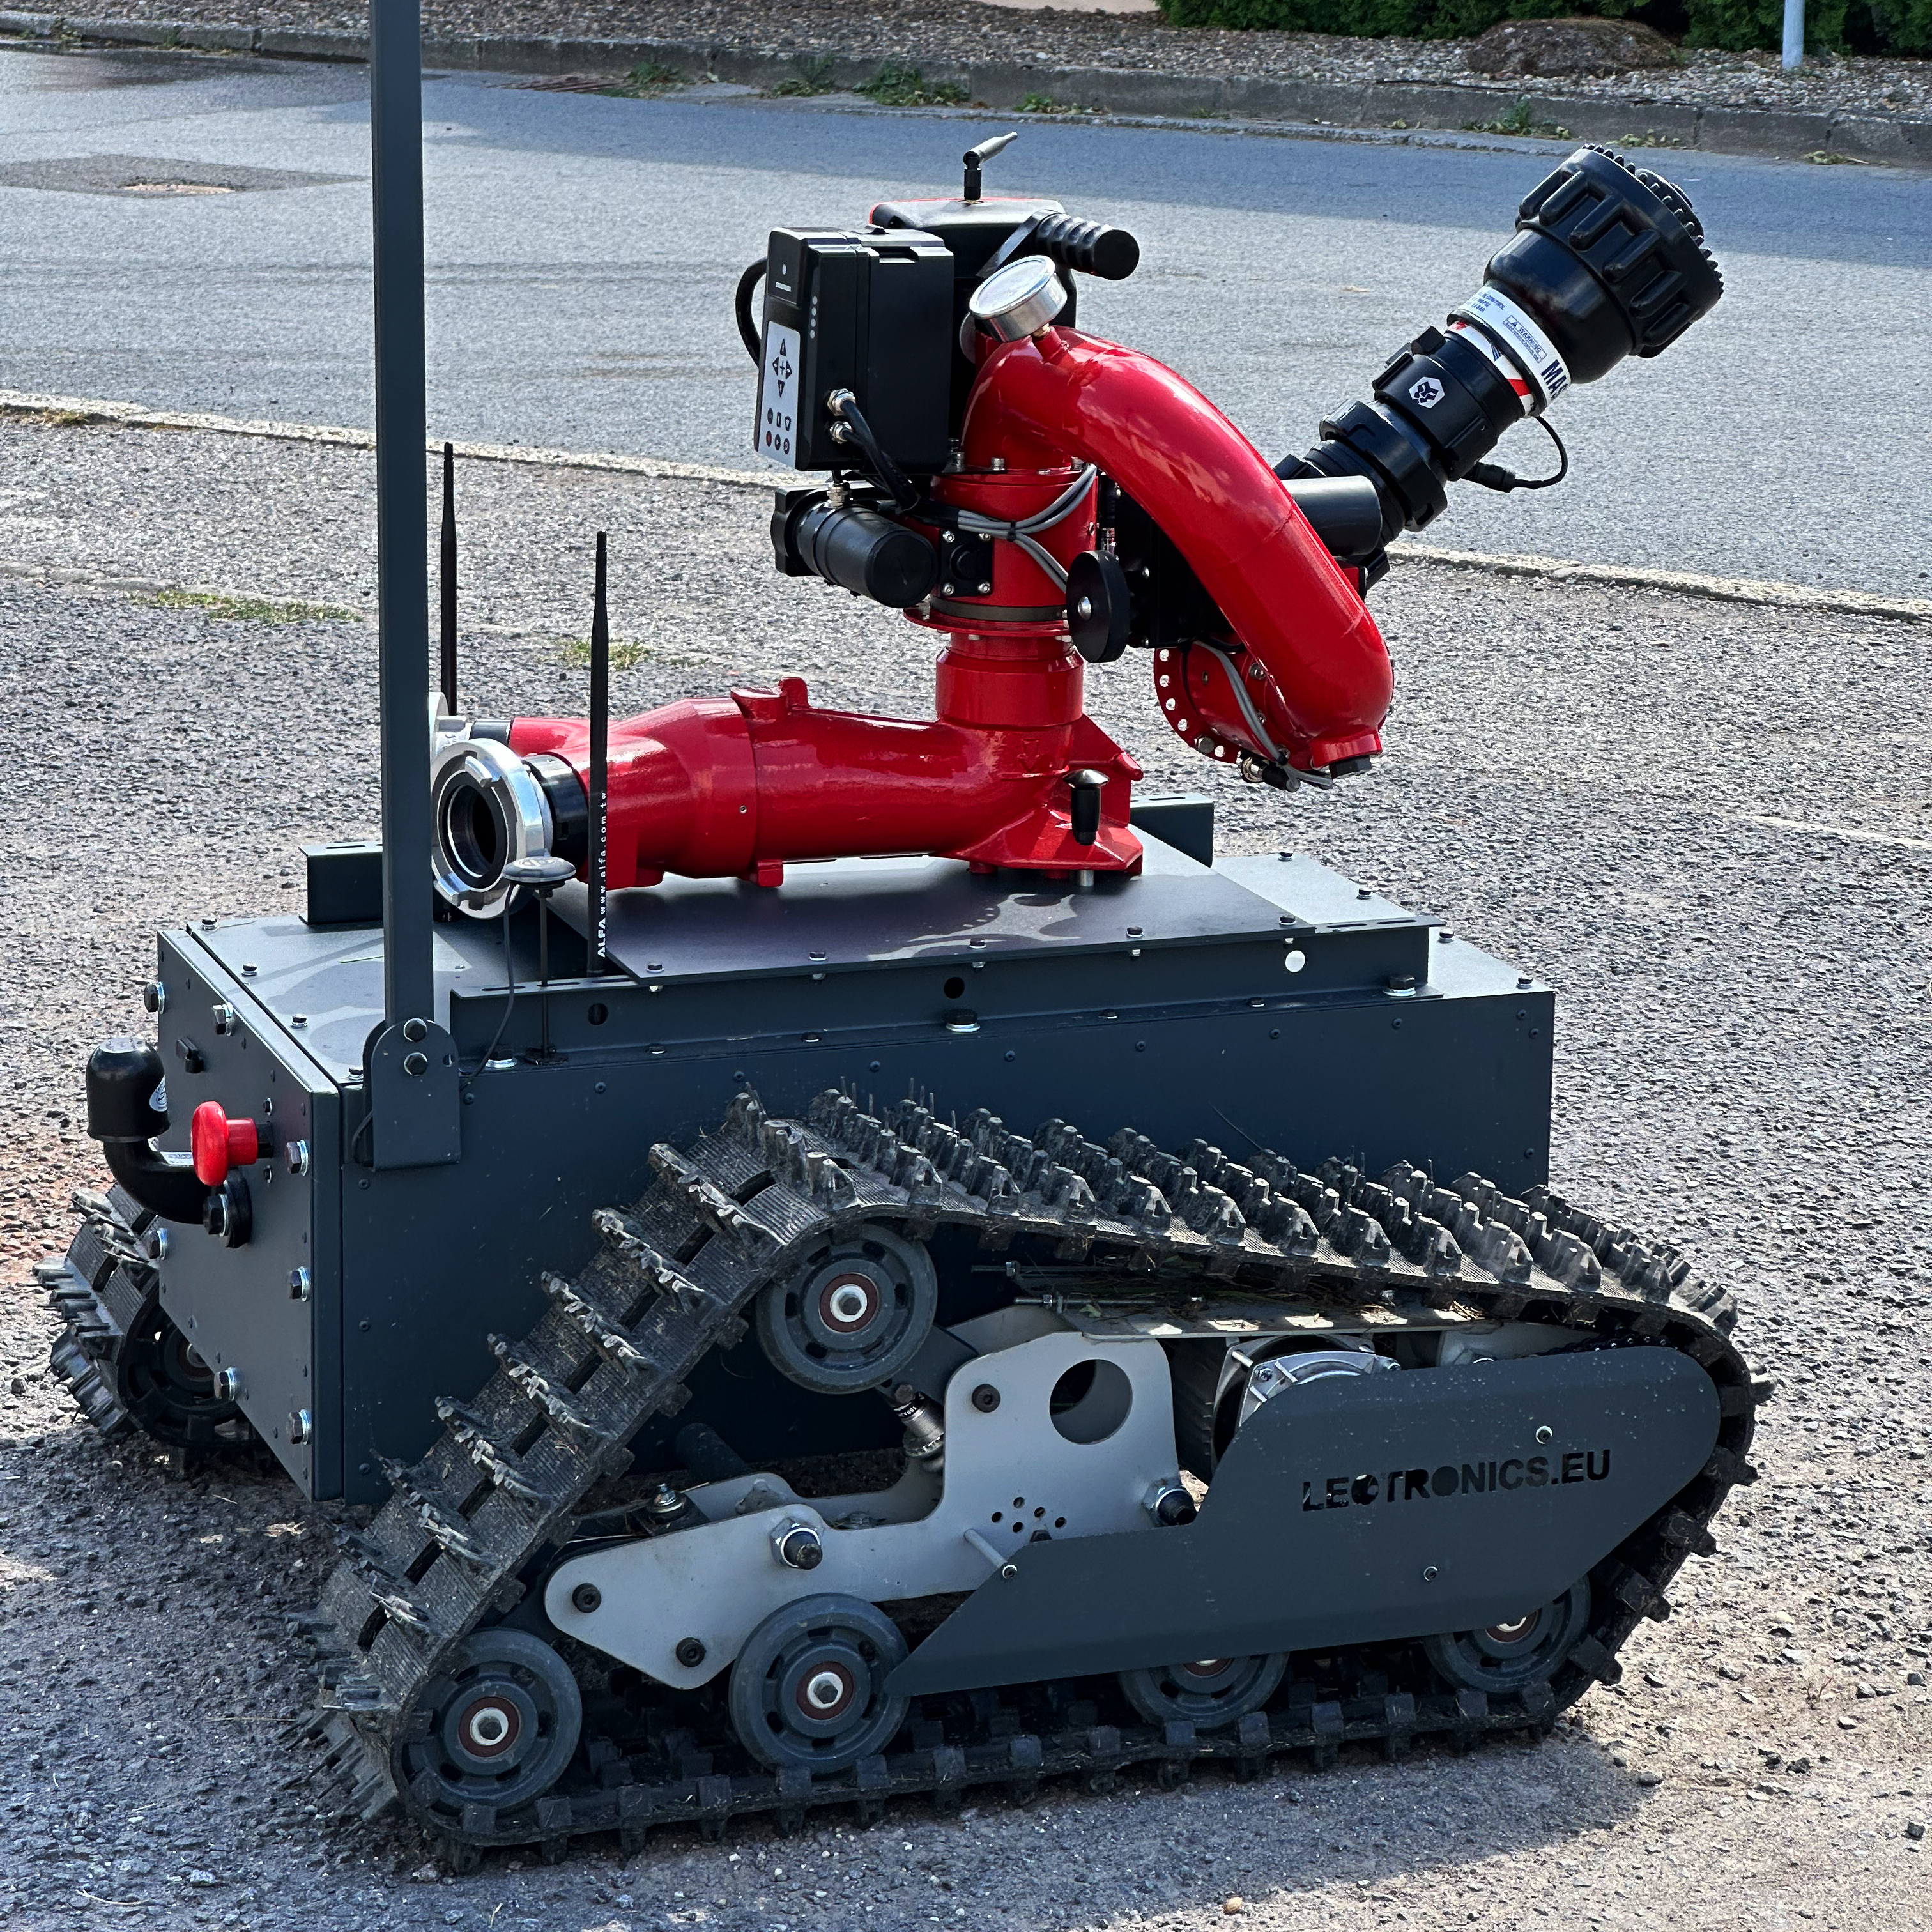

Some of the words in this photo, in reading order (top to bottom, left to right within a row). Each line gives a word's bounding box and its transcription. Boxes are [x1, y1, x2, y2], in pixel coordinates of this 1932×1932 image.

[1486, 295, 1506, 310] CONTROL
[1519, 327, 1542, 353] WARNING
[597, 917, 606, 958] ALFA
[1303, 1449, 1610, 1512] LECTRONICS.EU
